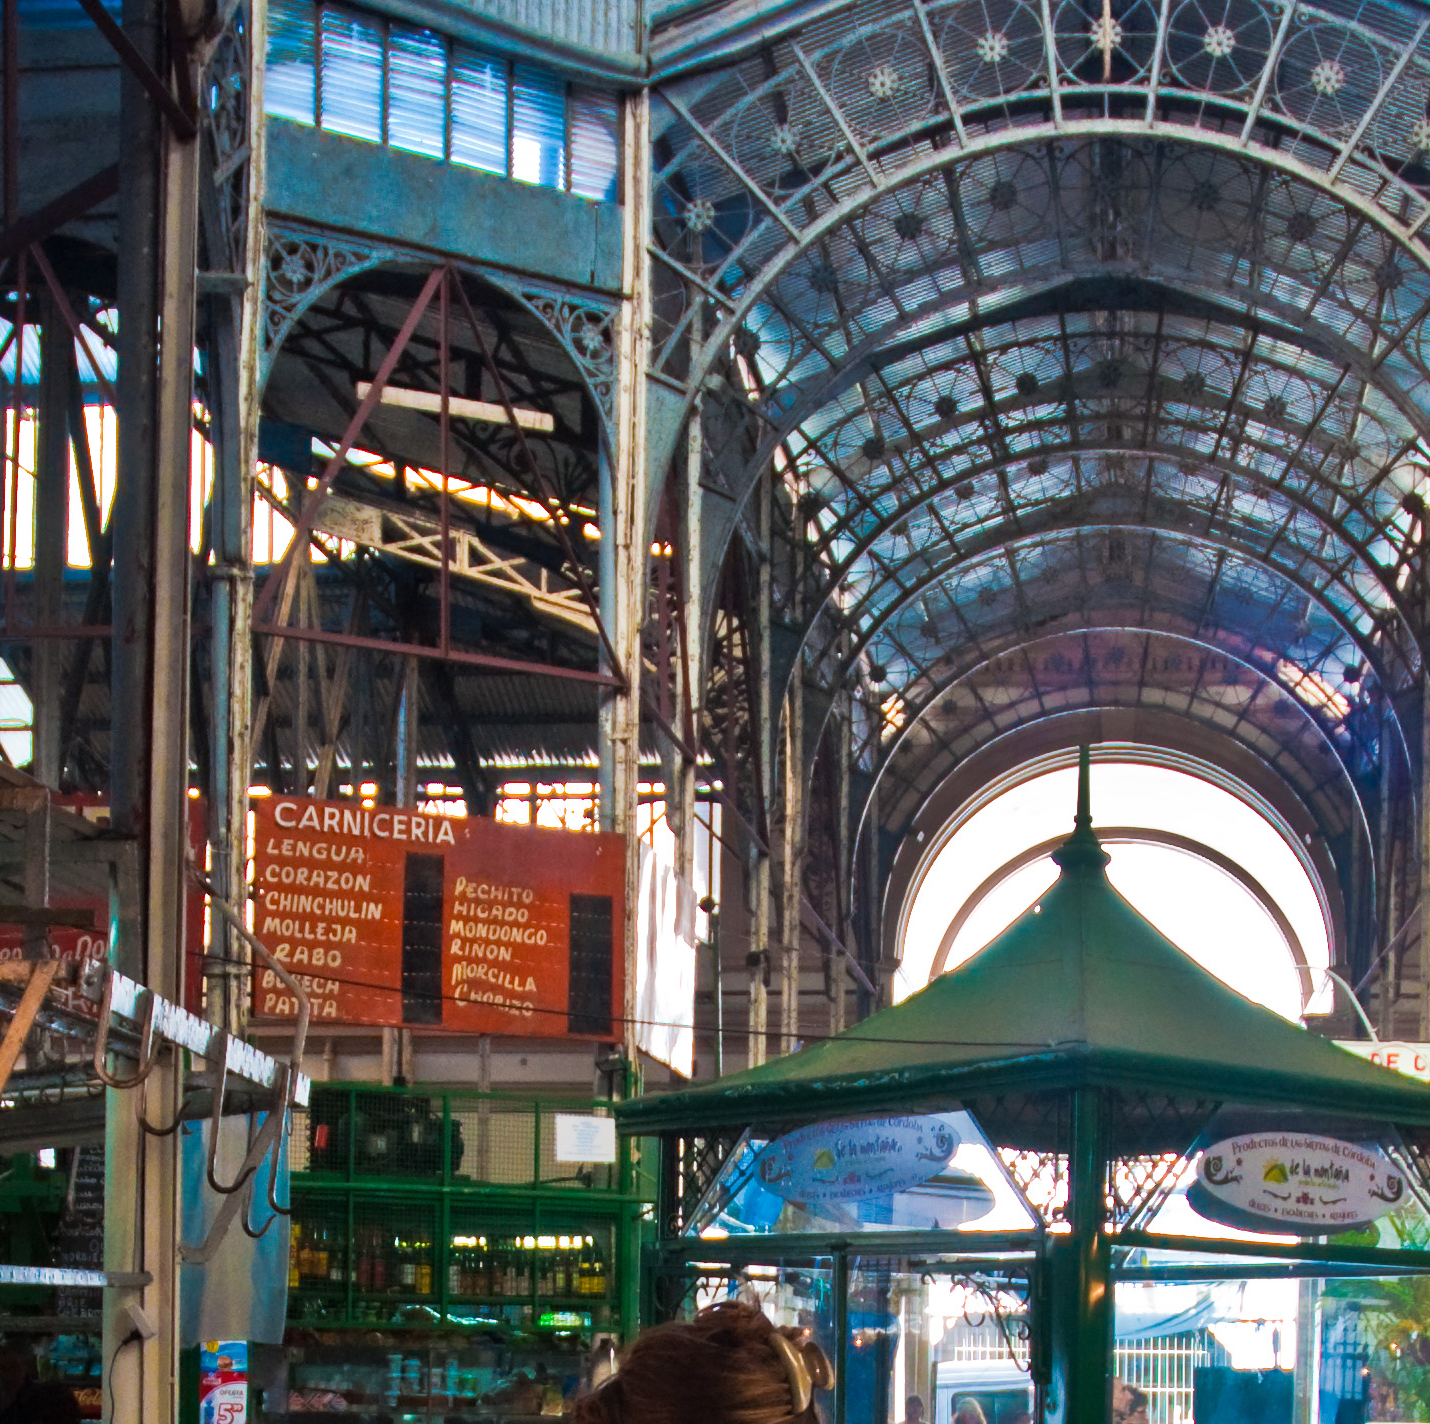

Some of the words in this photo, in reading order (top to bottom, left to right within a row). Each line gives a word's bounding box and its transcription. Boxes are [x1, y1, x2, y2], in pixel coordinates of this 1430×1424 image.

[274, 802, 455, 846] CARNICERIA
[266, 838, 365, 864] LENGUA
[265, 864, 371, 892] CORAZON
[455, 876, 534, 904] PECHITO
[264, 891, 382, 920] CHINCHULIN
[453, 900, 529, 923] HIGADO
[262, 916, 357, 943] MOLLEJA
[449, 919, 548, 946] MONDONGO
[273, 943, 342, 968] RABO
[450, 937, 512, 961] RIÑON
[451, 961, 538, 993] MORCILLA
[263, 993, 338, 1018] PATTA
[454, 983, 534, 1017] CHORIZO
[1289, 1158, 1301, 1177] de
[1302, 1158, 1312, 1177] la
